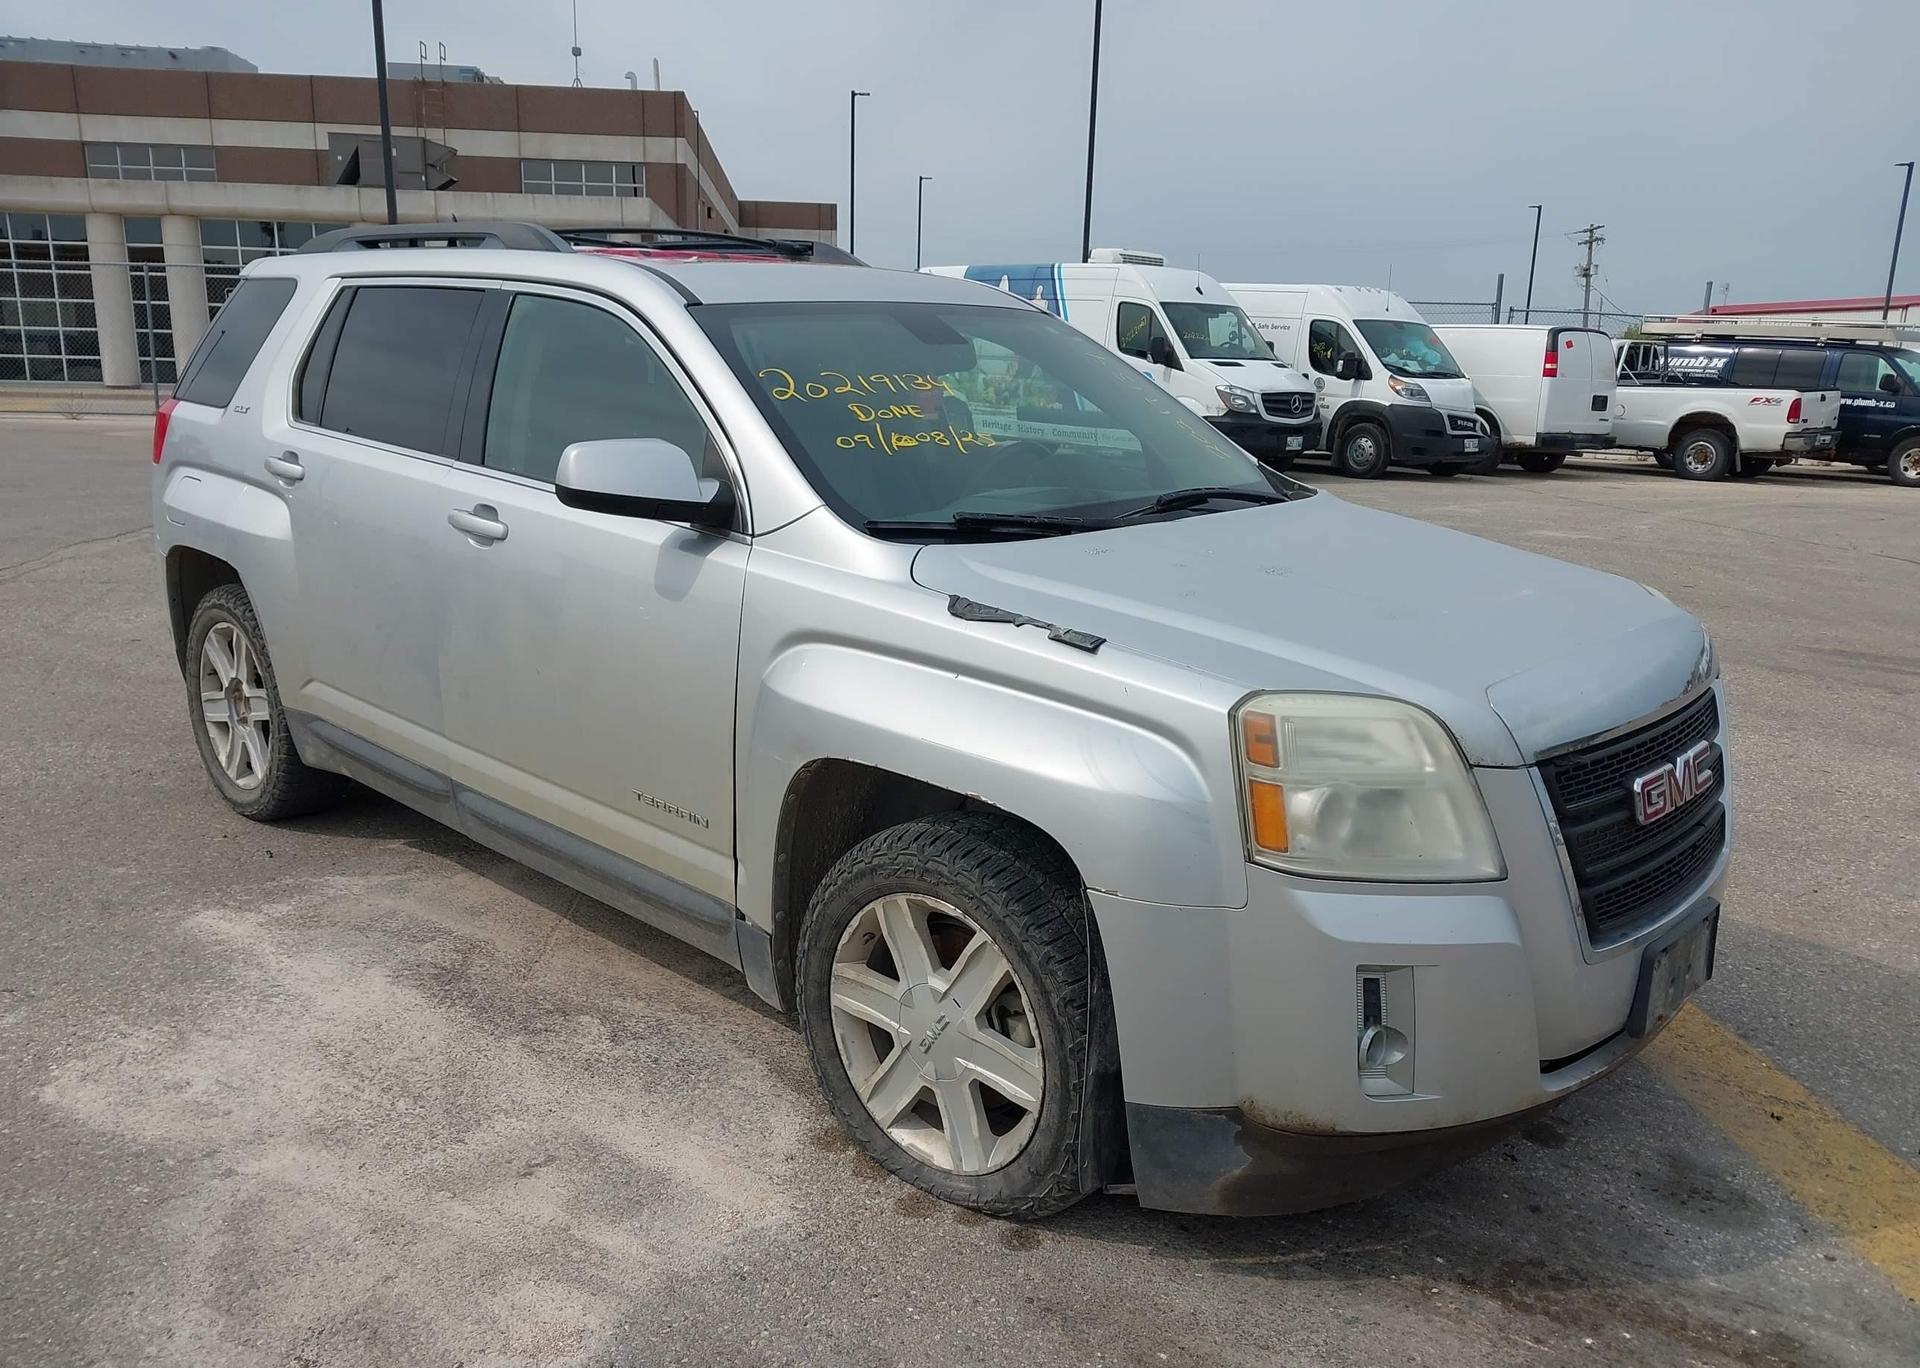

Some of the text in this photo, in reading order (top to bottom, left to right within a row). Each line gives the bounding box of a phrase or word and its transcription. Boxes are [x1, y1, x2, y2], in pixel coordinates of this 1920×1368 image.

[759, 368, 953, 402] 20219134
[1840, 398, 1896, 408] ww.plumb-x.ca
[982, 419, 1012, 432] Heritage
[1018, 424, 1046, 437] History
[1052, 428, 1098, 442] Community
[1634, 740, 1713, 825] GMC
[631, 788, 709, 829] TERRAIN
[919, 1014, 950, 1054] GMC
